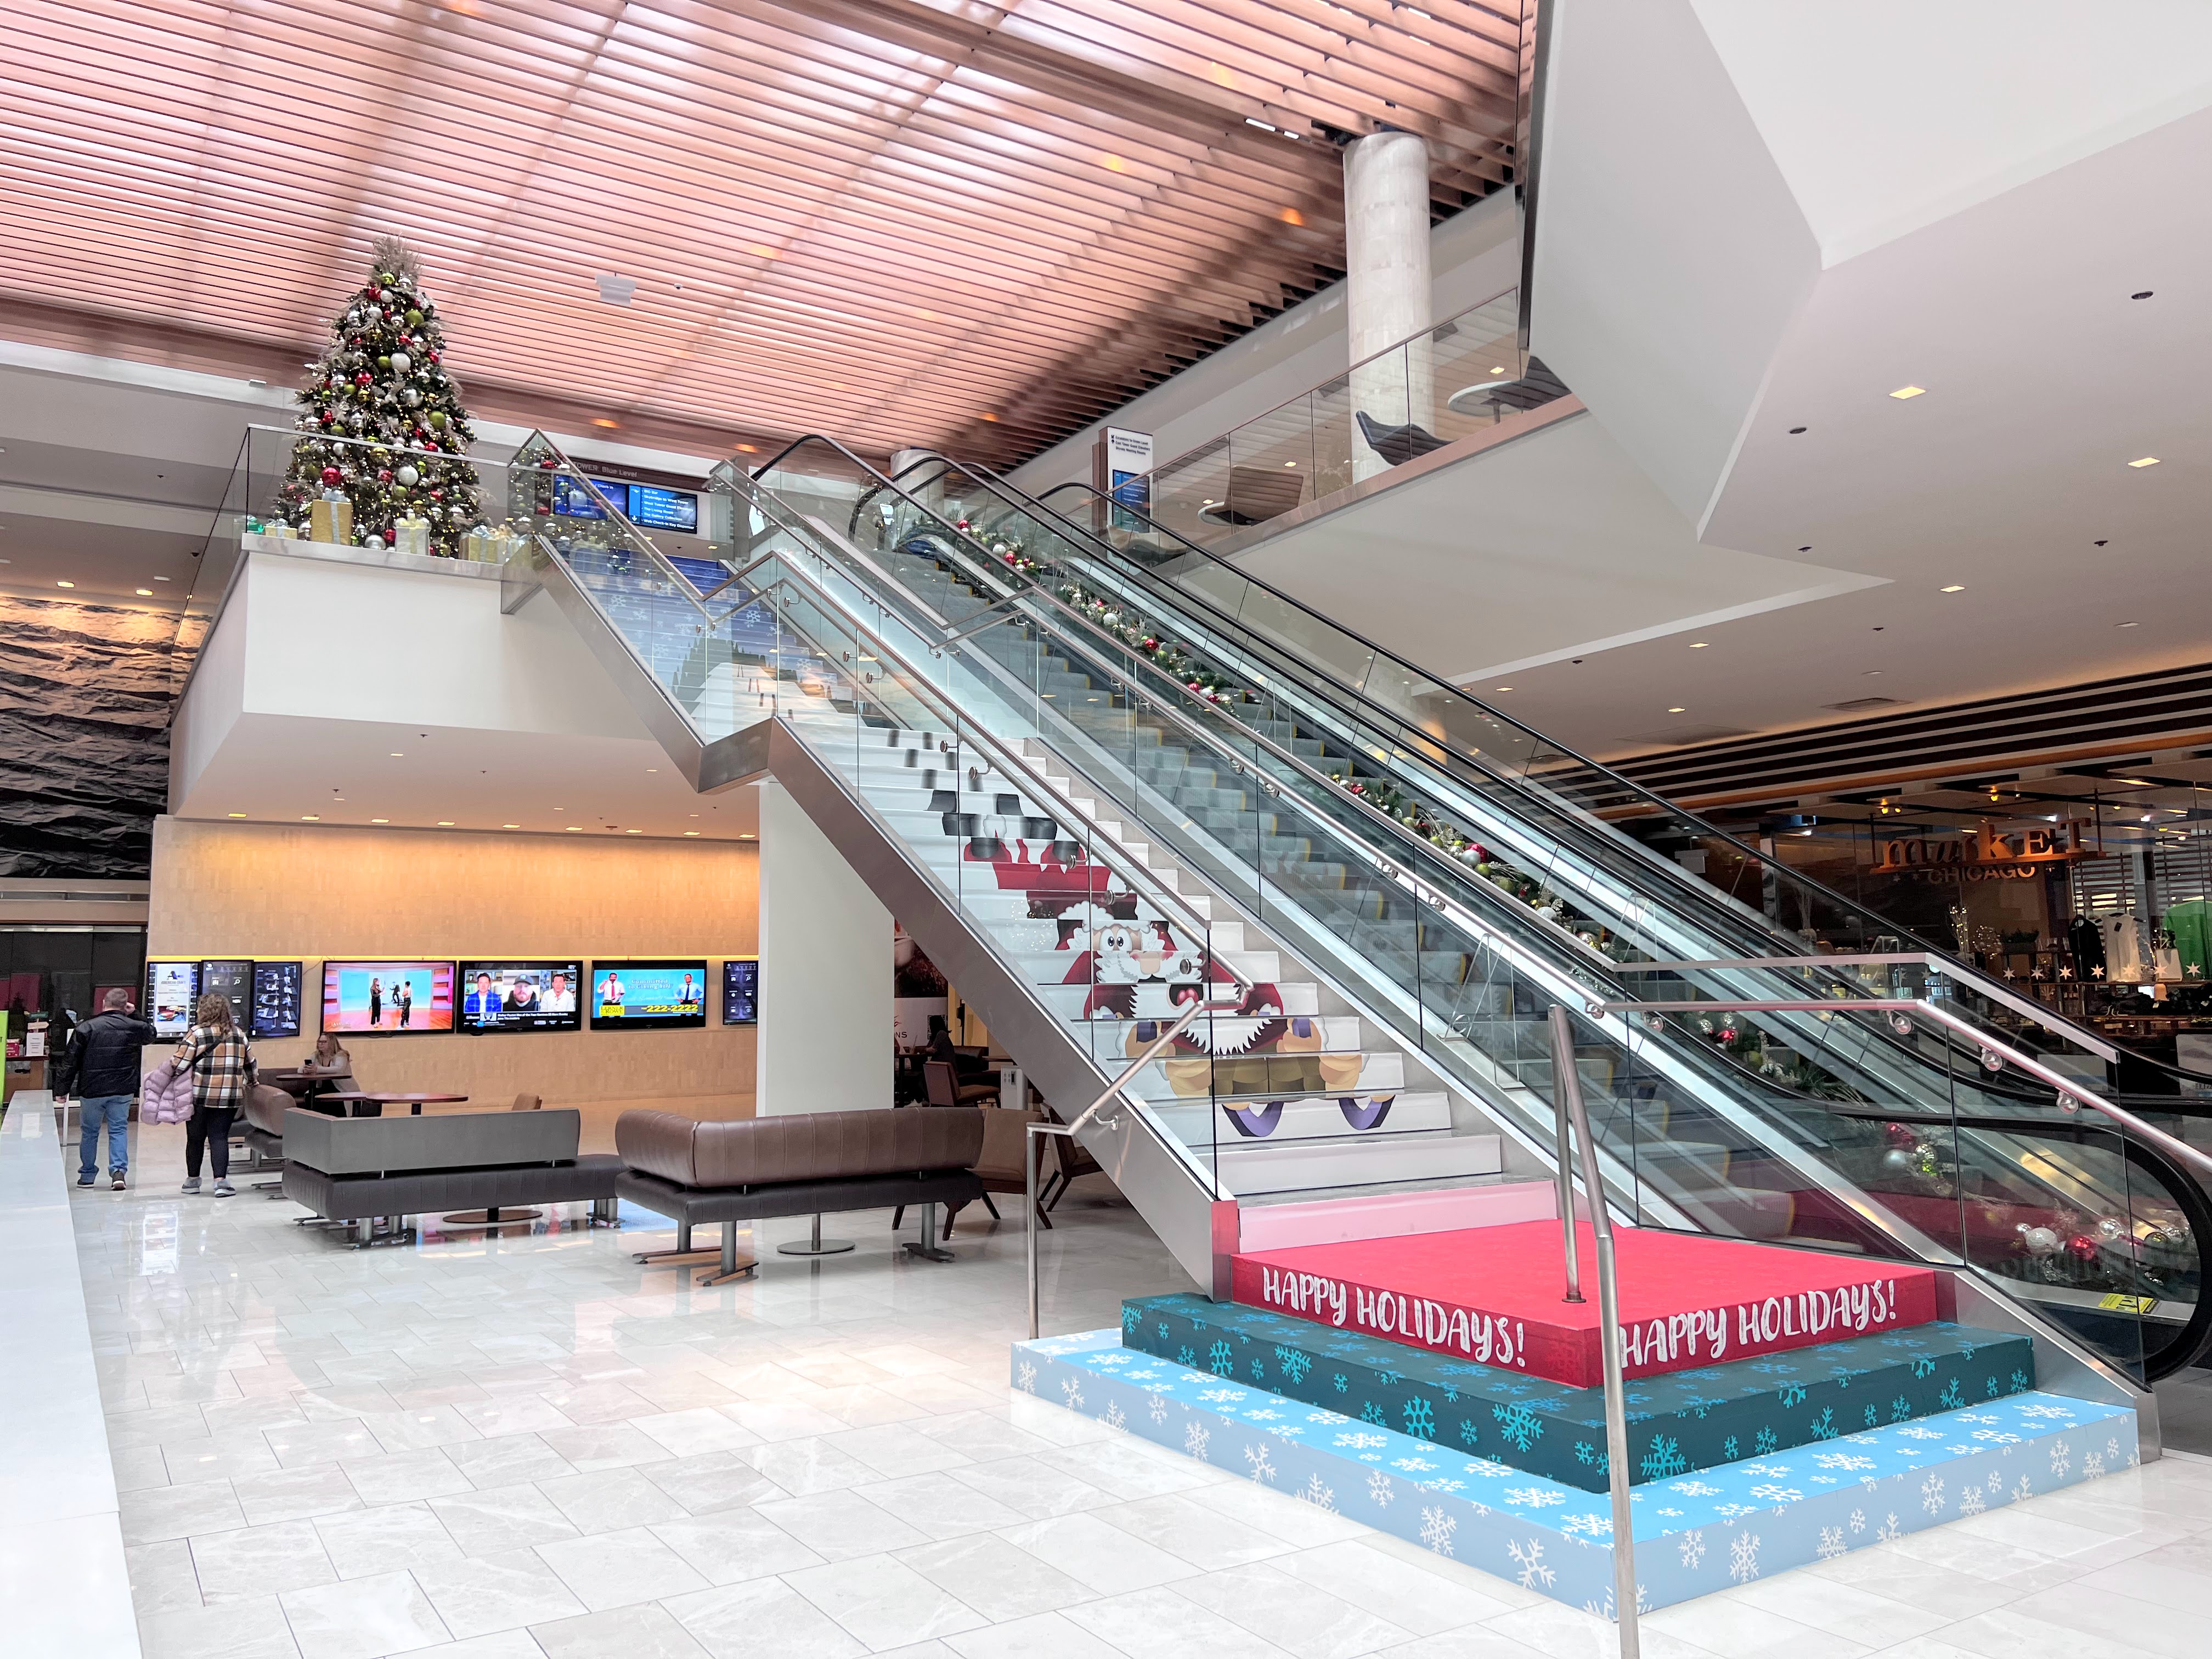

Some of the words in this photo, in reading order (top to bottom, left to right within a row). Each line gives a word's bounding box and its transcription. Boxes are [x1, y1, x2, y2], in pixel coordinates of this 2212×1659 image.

[619, 469, 637, 477] Level
[1927, 866, 2035, 884] CHICAGO
[1263, 1266, 1347, 1326] HAPPY
[1356, 1287, 1525, 1367] HOLIDAYS!
[1619, 1307, 1726, 1368] HAPPY
[1738, 1279, 1896, 1345] HOLIDAYS!
